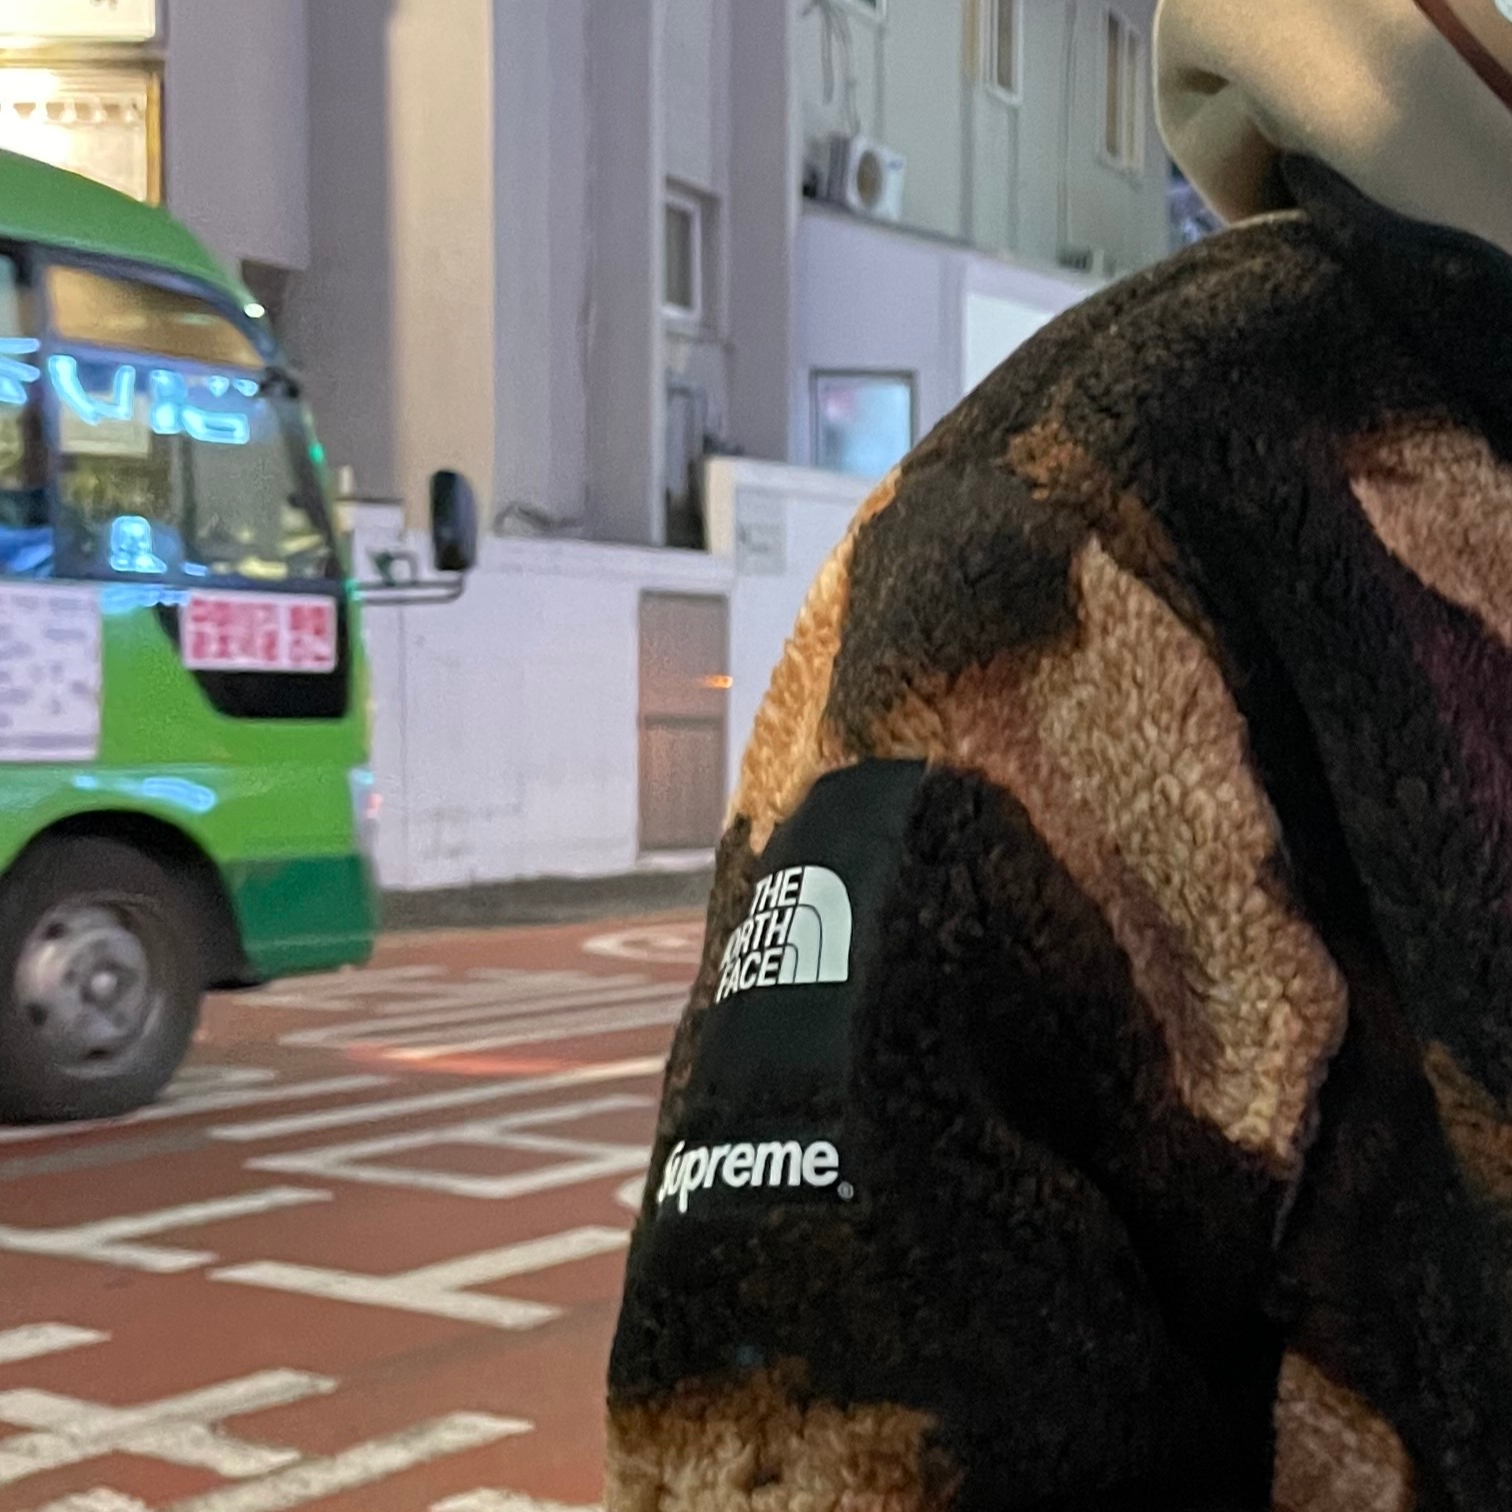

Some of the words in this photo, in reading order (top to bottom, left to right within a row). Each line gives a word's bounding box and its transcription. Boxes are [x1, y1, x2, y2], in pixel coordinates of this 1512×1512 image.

[750, 865, 803, 917] THE
[718, 906, 794, 973] ORTH
[715, 947, 784, 1004] FACE
